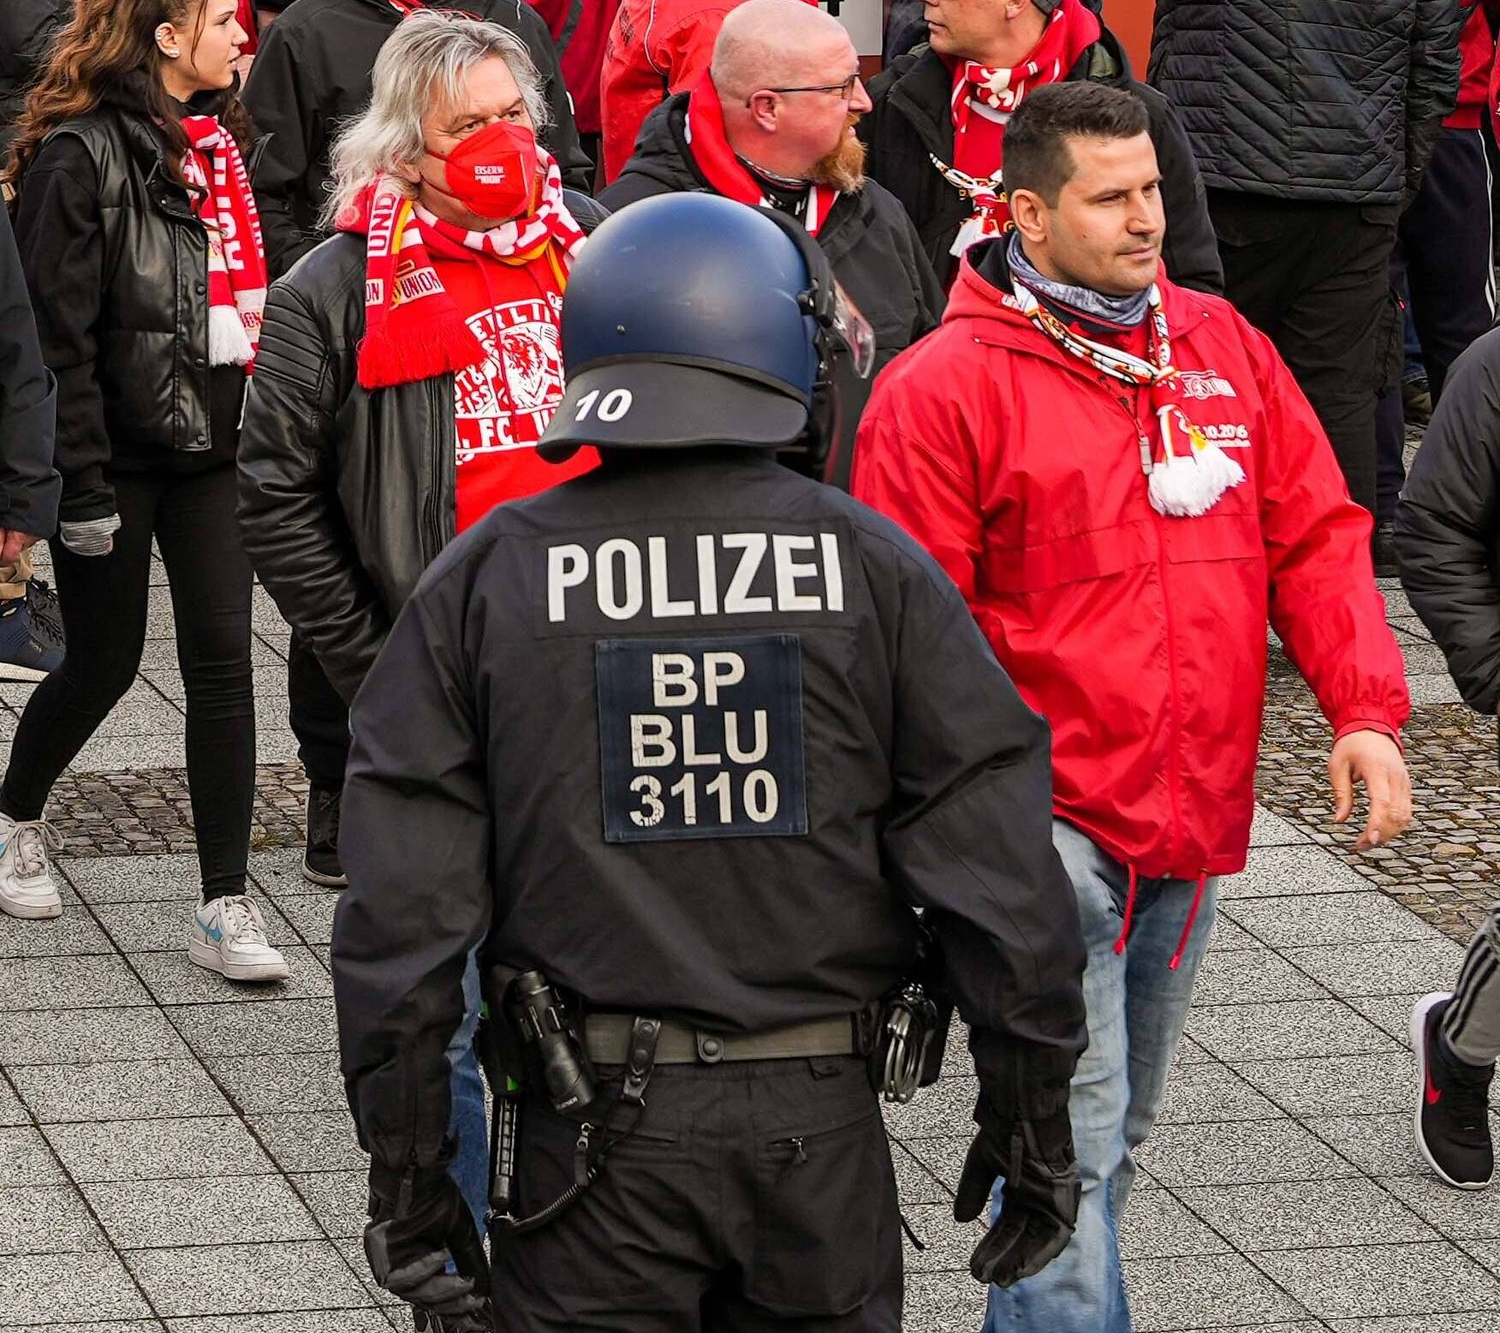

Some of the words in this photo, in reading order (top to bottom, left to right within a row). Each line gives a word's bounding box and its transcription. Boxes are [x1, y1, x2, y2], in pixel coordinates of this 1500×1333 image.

[478, 416, 514, 449] FC
[573, 388, 632, 423] 10
[547, 532, 844, 623] POLIZEI
[652, 651, 745, 707] BP
[630, 711, 768, 768] BLU
[629, 769, 779, 827] 3110
